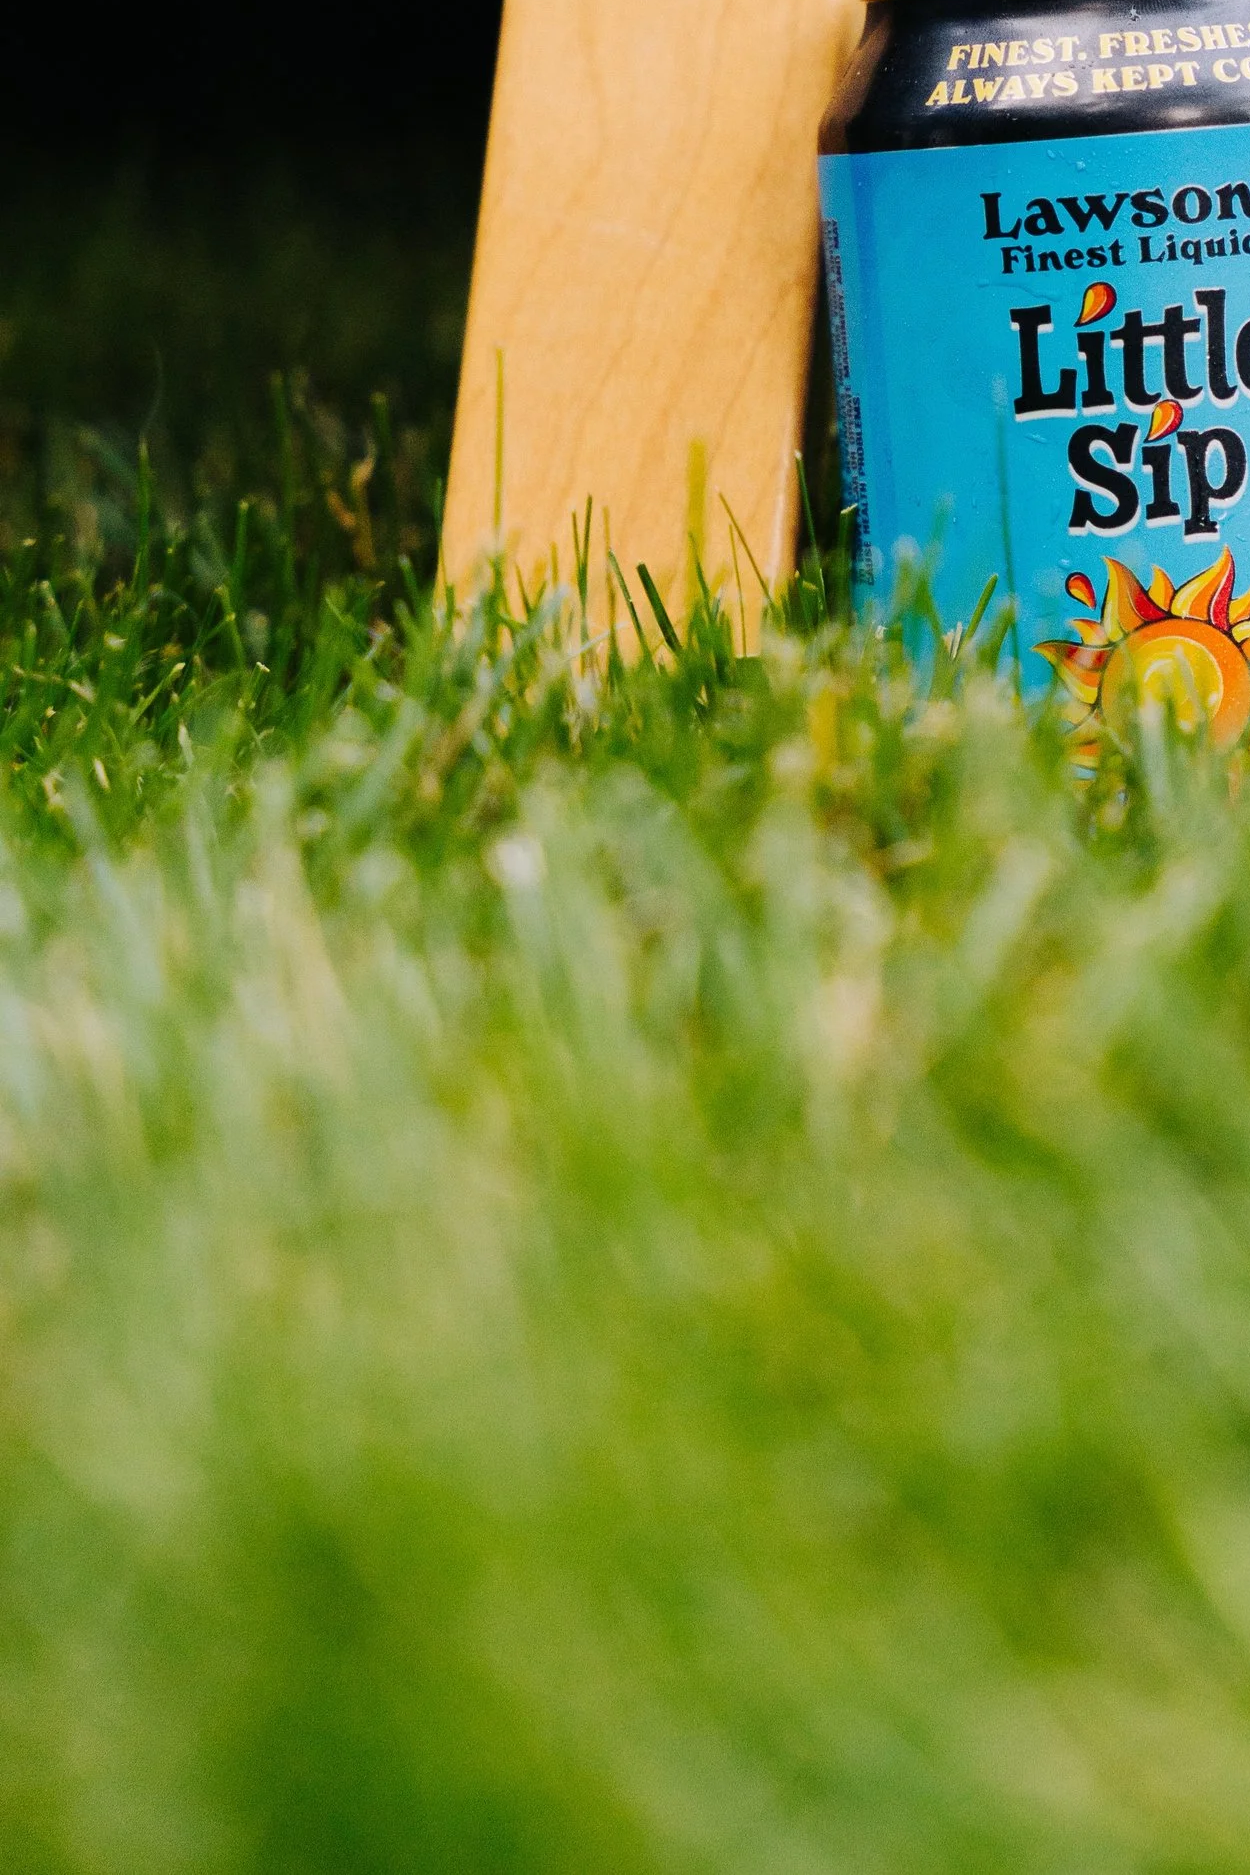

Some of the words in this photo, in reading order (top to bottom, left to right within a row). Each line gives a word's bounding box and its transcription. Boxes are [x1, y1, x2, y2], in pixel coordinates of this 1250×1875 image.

[947, 35, 1088, 72] FINEST.
[925, 69, 1080, 107] ALWAYS
[1091, 60, 1201, 95] KEPT
[1000, 237, 1127, 275] Finest
[1067, 397, 1249, 545] Sip
[859, 483, 869, 535] HEALTH
